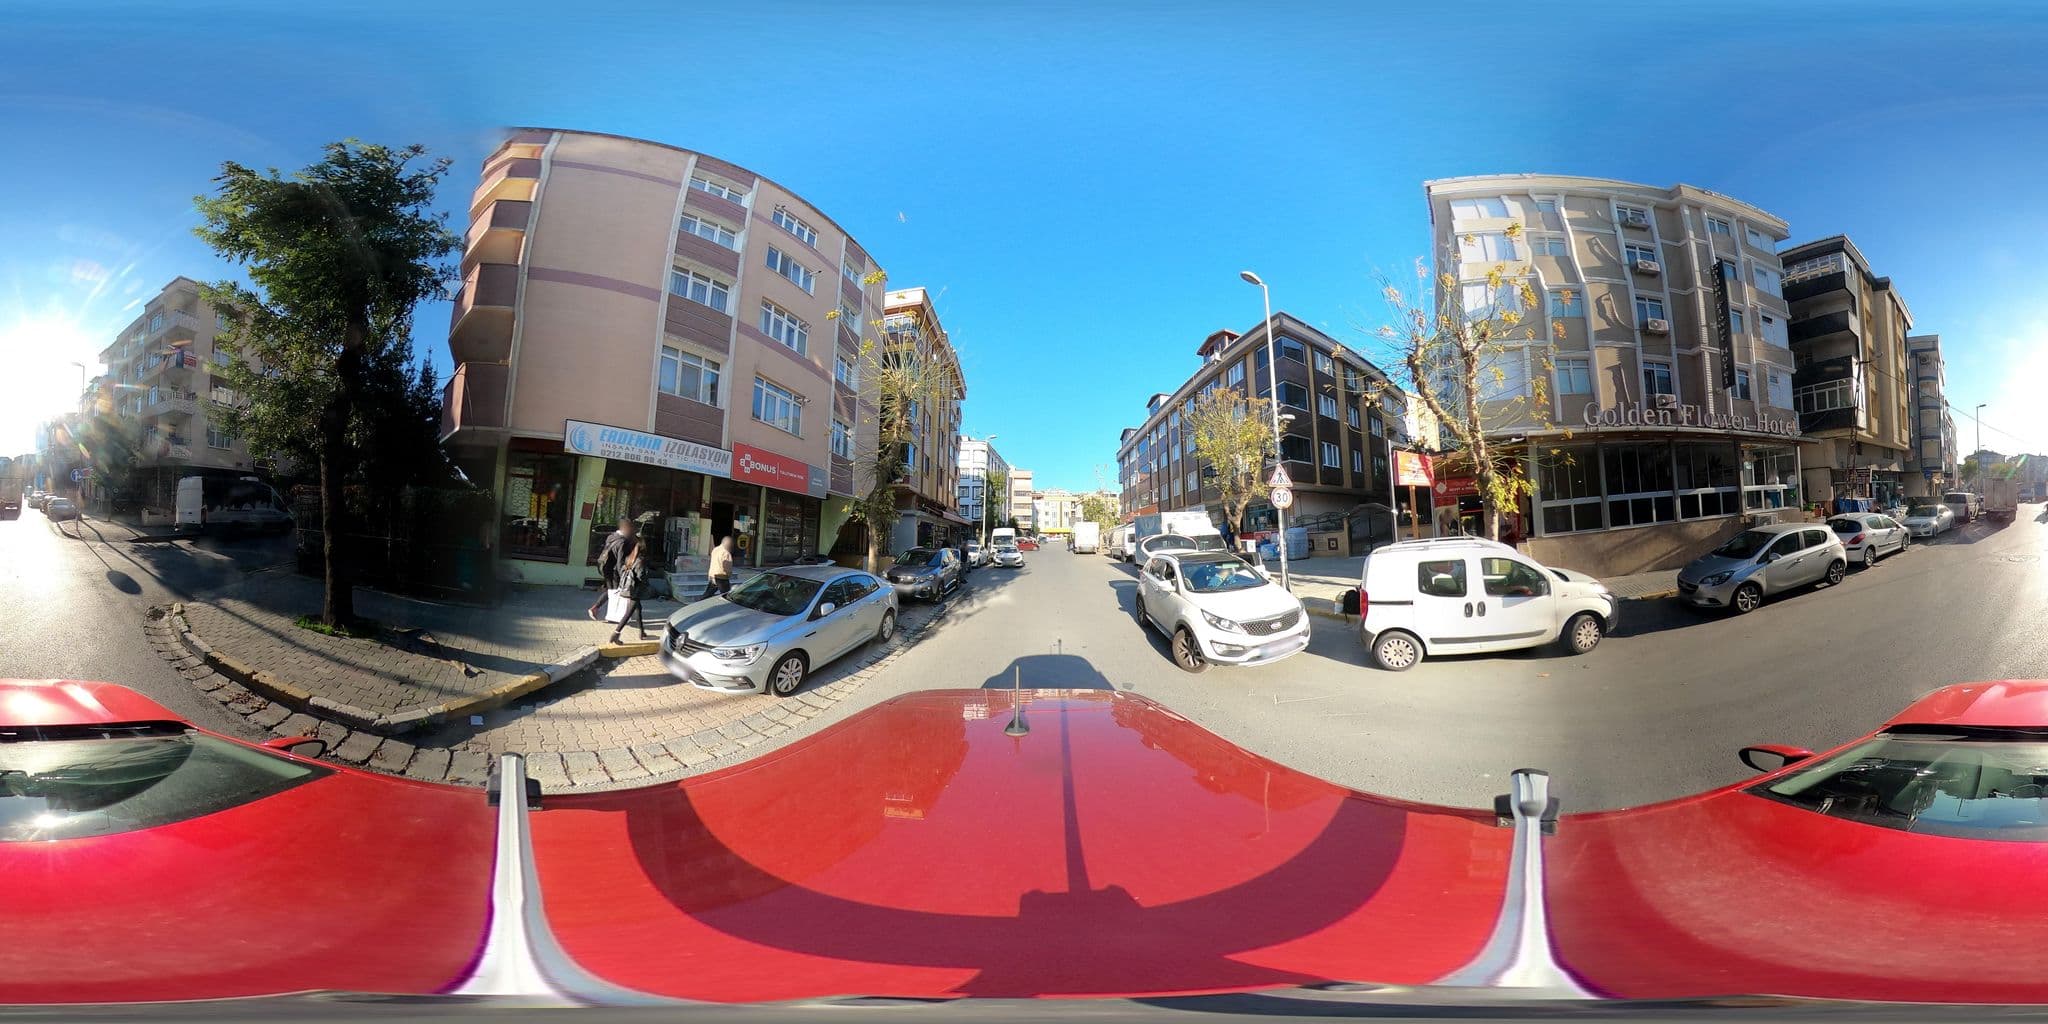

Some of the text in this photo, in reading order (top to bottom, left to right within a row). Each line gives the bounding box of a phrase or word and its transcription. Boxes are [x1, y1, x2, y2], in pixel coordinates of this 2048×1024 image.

[1583, 401, 1800, 436] Golden Flower Hotel
[600, 449, 622, 459] 0212
[749, 460, 777, 475] BONUS
[1276, 492, 1288, 503] 30
